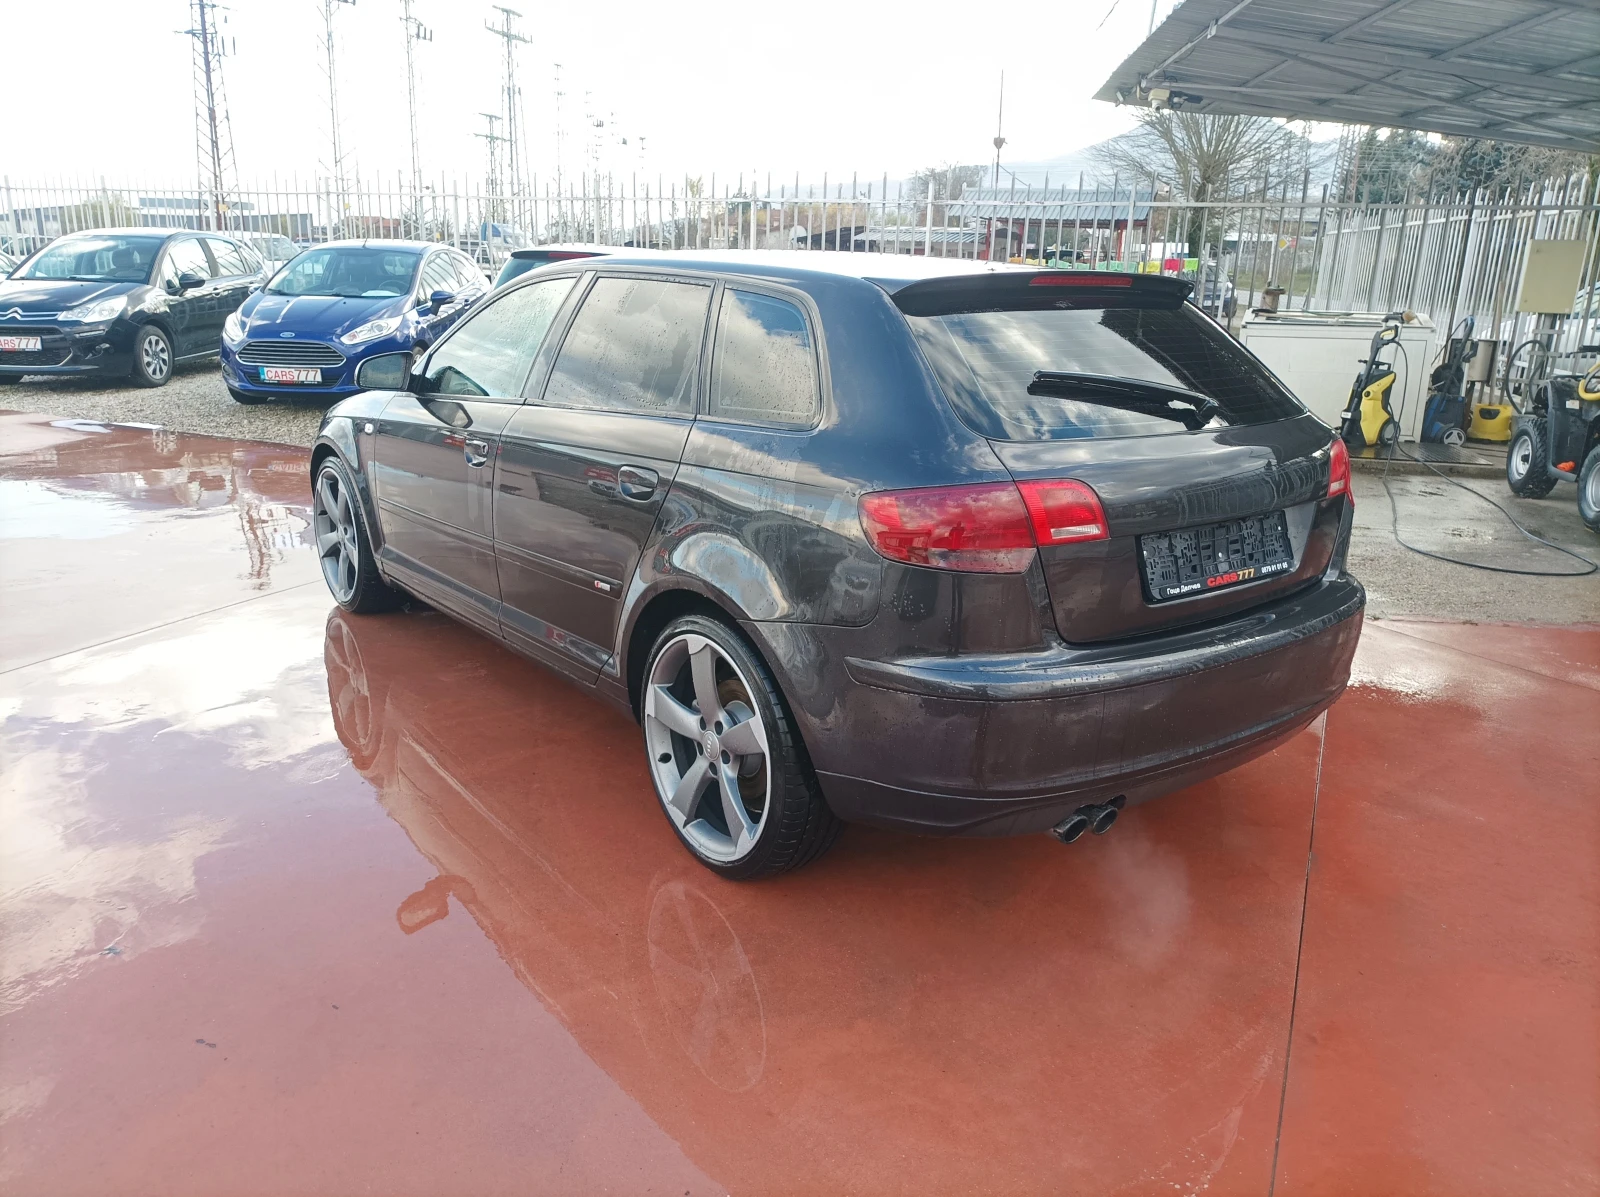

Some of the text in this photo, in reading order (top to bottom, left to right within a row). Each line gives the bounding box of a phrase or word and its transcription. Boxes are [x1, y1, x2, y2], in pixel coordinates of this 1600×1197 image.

[0, 337, 39, 349] ARS777
[266, 369, 319, 381] CARS777
[1207, 568, 1254, 586] CARS777
